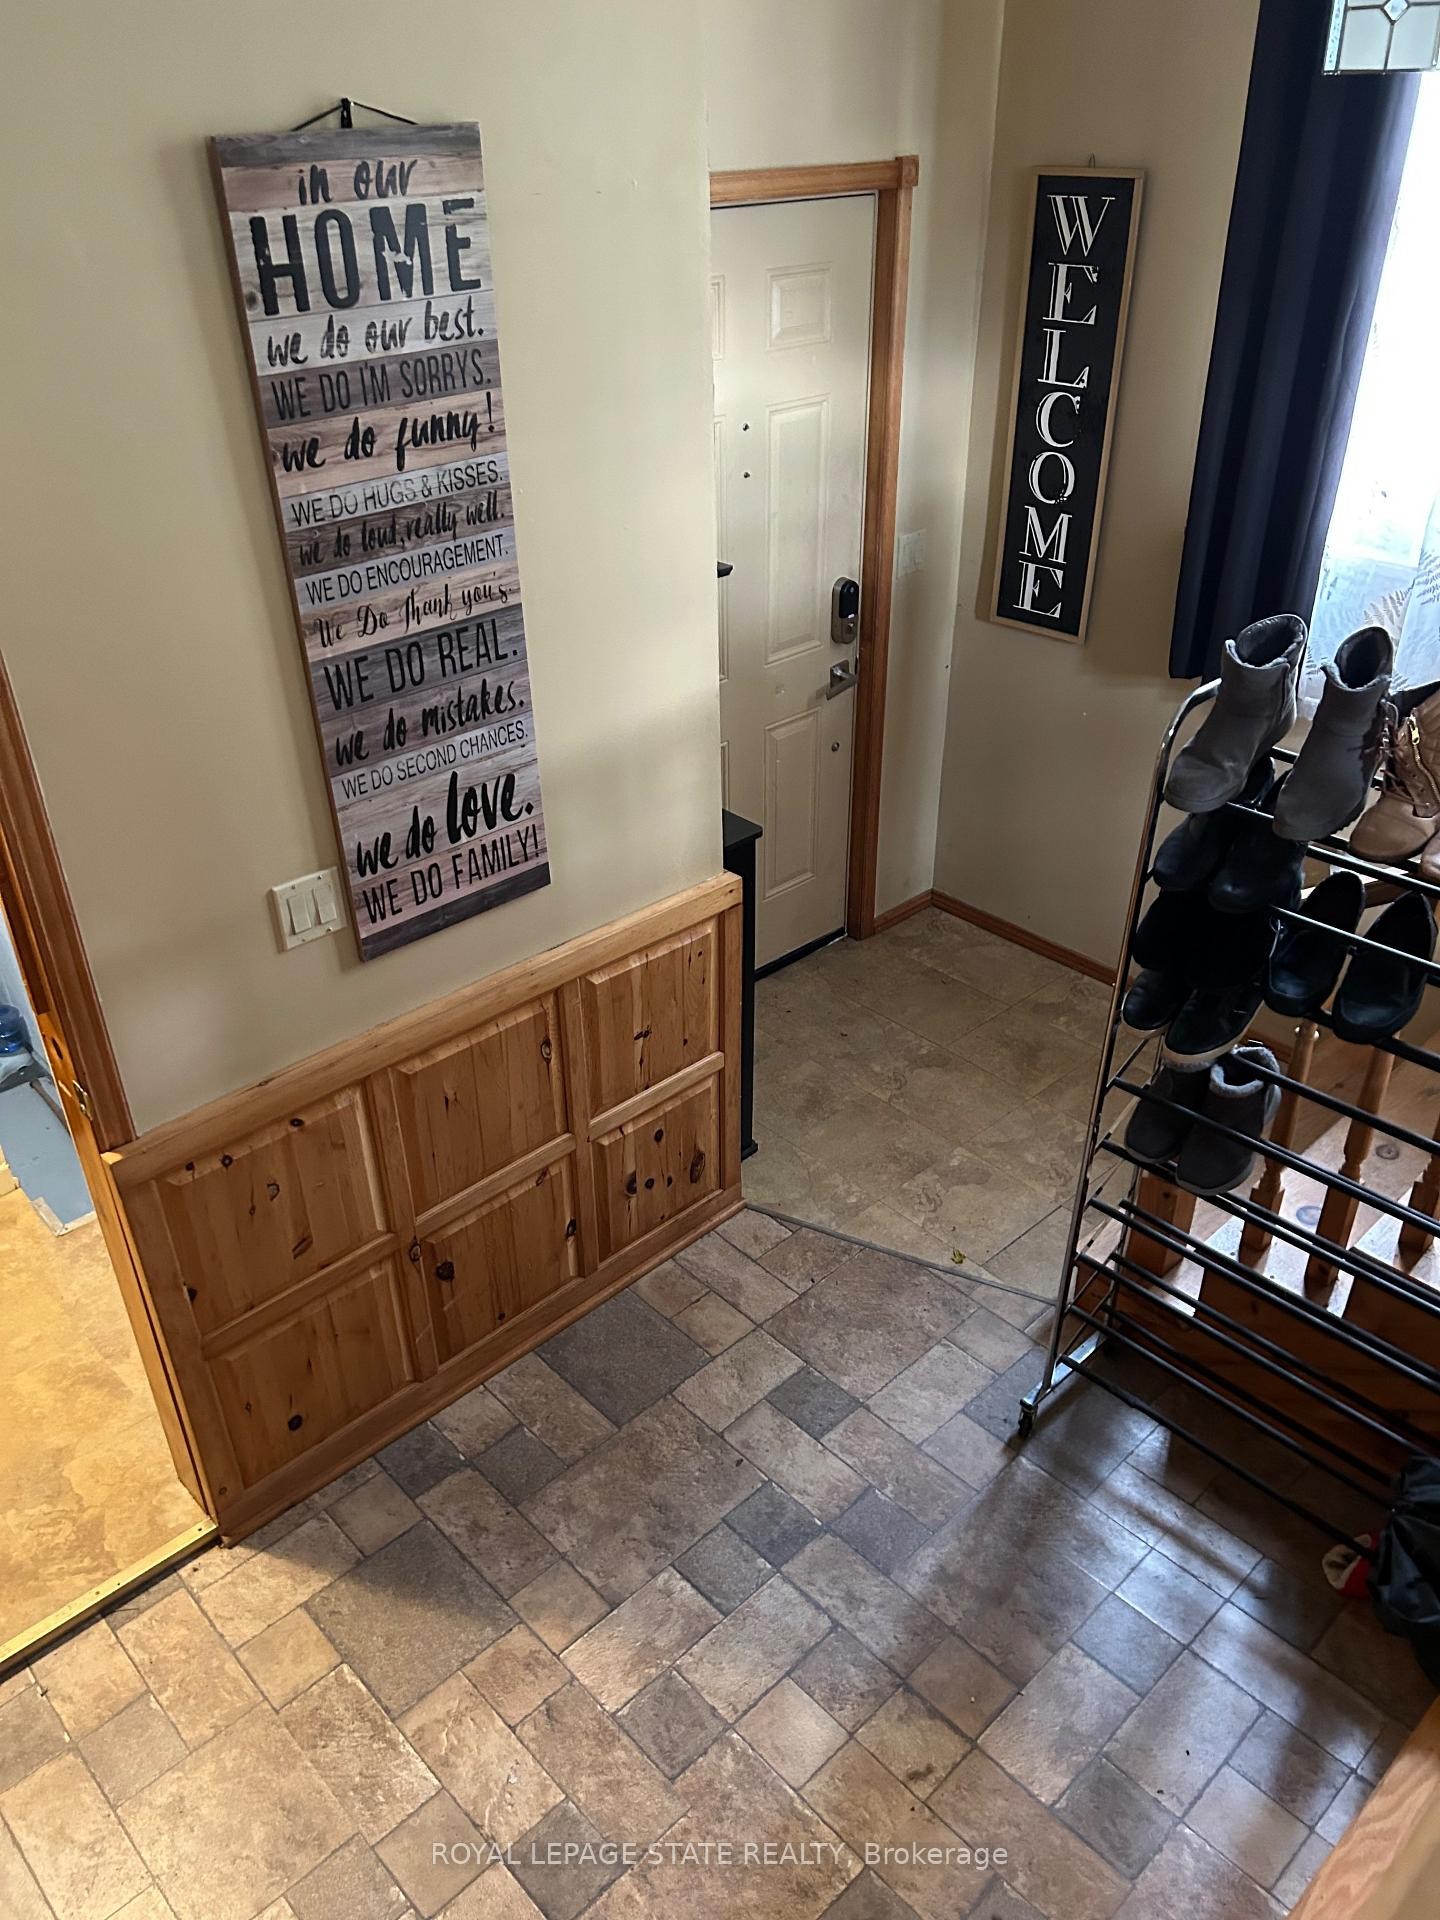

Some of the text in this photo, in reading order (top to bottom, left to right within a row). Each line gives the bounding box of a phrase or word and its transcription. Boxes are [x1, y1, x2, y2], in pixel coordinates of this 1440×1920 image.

[299, 159, 418, 205] in our
[249, 198, 481, 316] HOME
[267, 296, 484, 367] we do our best.
[271, 349, 491, 420] WE DO I'M SORRYS.
[1013, 194, 1115, 619] WELCOME
[282, 391, 495, 472] we do funny!
[291, 460, 503, 527] WE DO HUGS & KISSES.
[300, 541, 324, 566] we
[334, 527, 351, 558] do
[406, 501, 458, 540] really
[466, 490, 504, 526] well.
[305, 534, 508, 605] WE DO ENCOURAGEMENT.
[314, 618, 344, 648] We
[357, 603, 390, 637] Do
[324, 618, 518, 710] WE DO REAL.
[336, 678, 525, 766] we do mistakes.
[341, 720, 528, 799] WE DO SECOND CHANCES.
[356, 771, 534, 877] we do love.
[362, 824, 539, 924] WE DO FAMILY!
